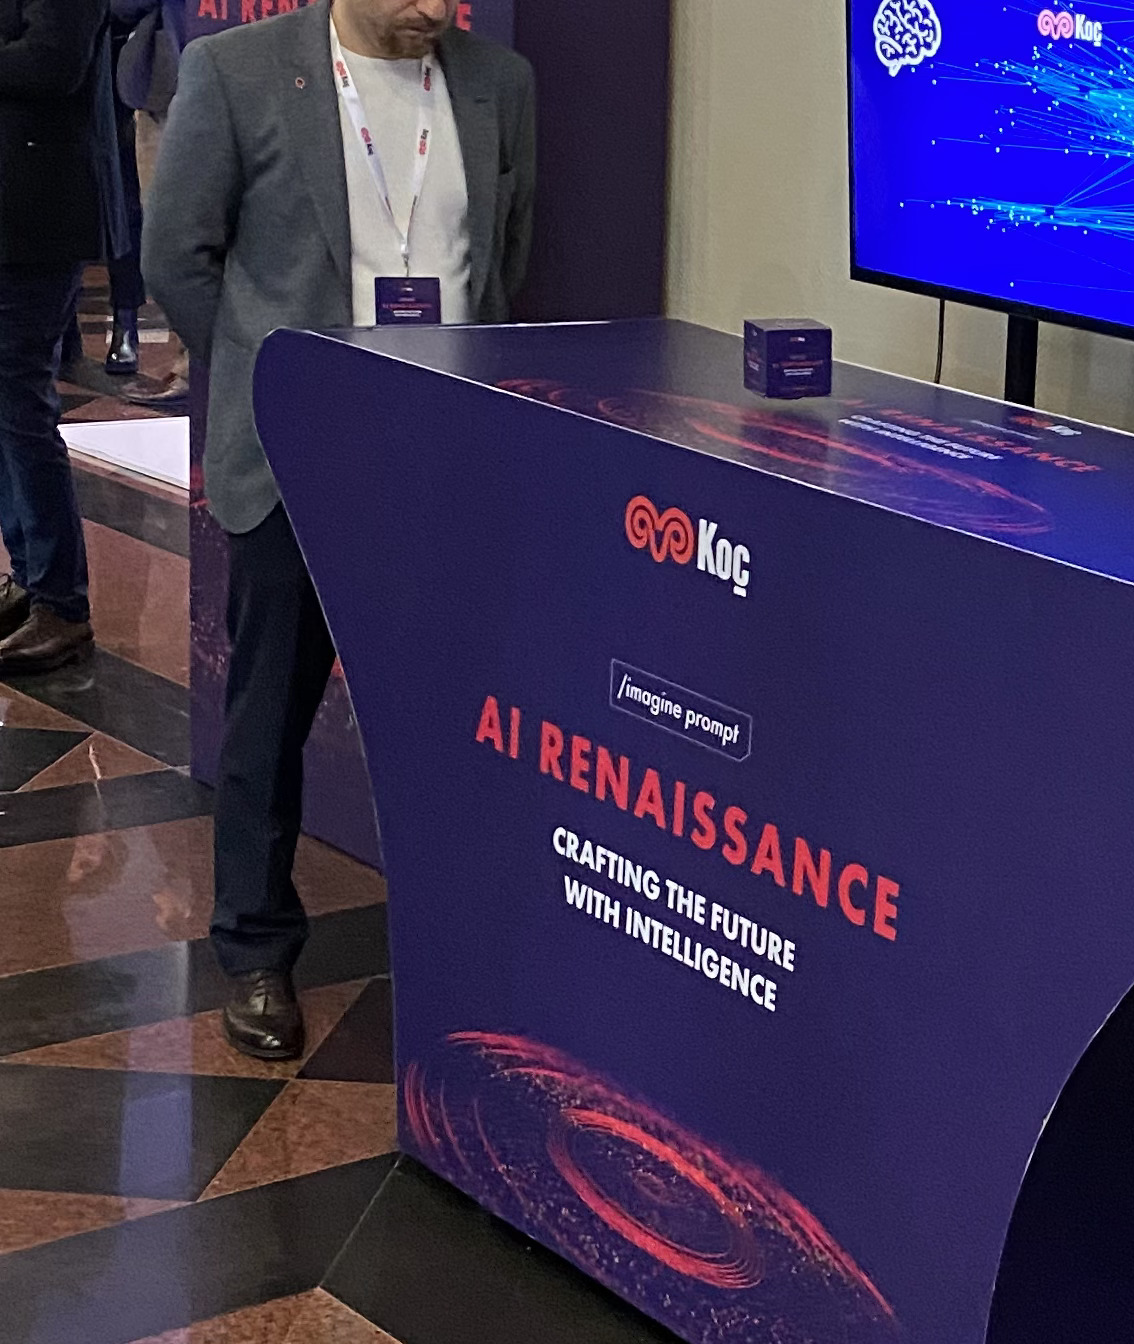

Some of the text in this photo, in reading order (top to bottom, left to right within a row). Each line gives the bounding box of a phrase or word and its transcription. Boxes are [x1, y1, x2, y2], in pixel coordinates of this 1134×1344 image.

[1075, 13, 1103, 47] Koç
[697, 518, 751, 598] Koç
[616, 672, 740, 745] /imagine prompt
[475, 695, 900, 942] AI RENAISSANCE
[552, 826, 796, 973] CRAFTING THE FUTURE
[563, 875, 778, 1013] WITH INTELLIGENCE
